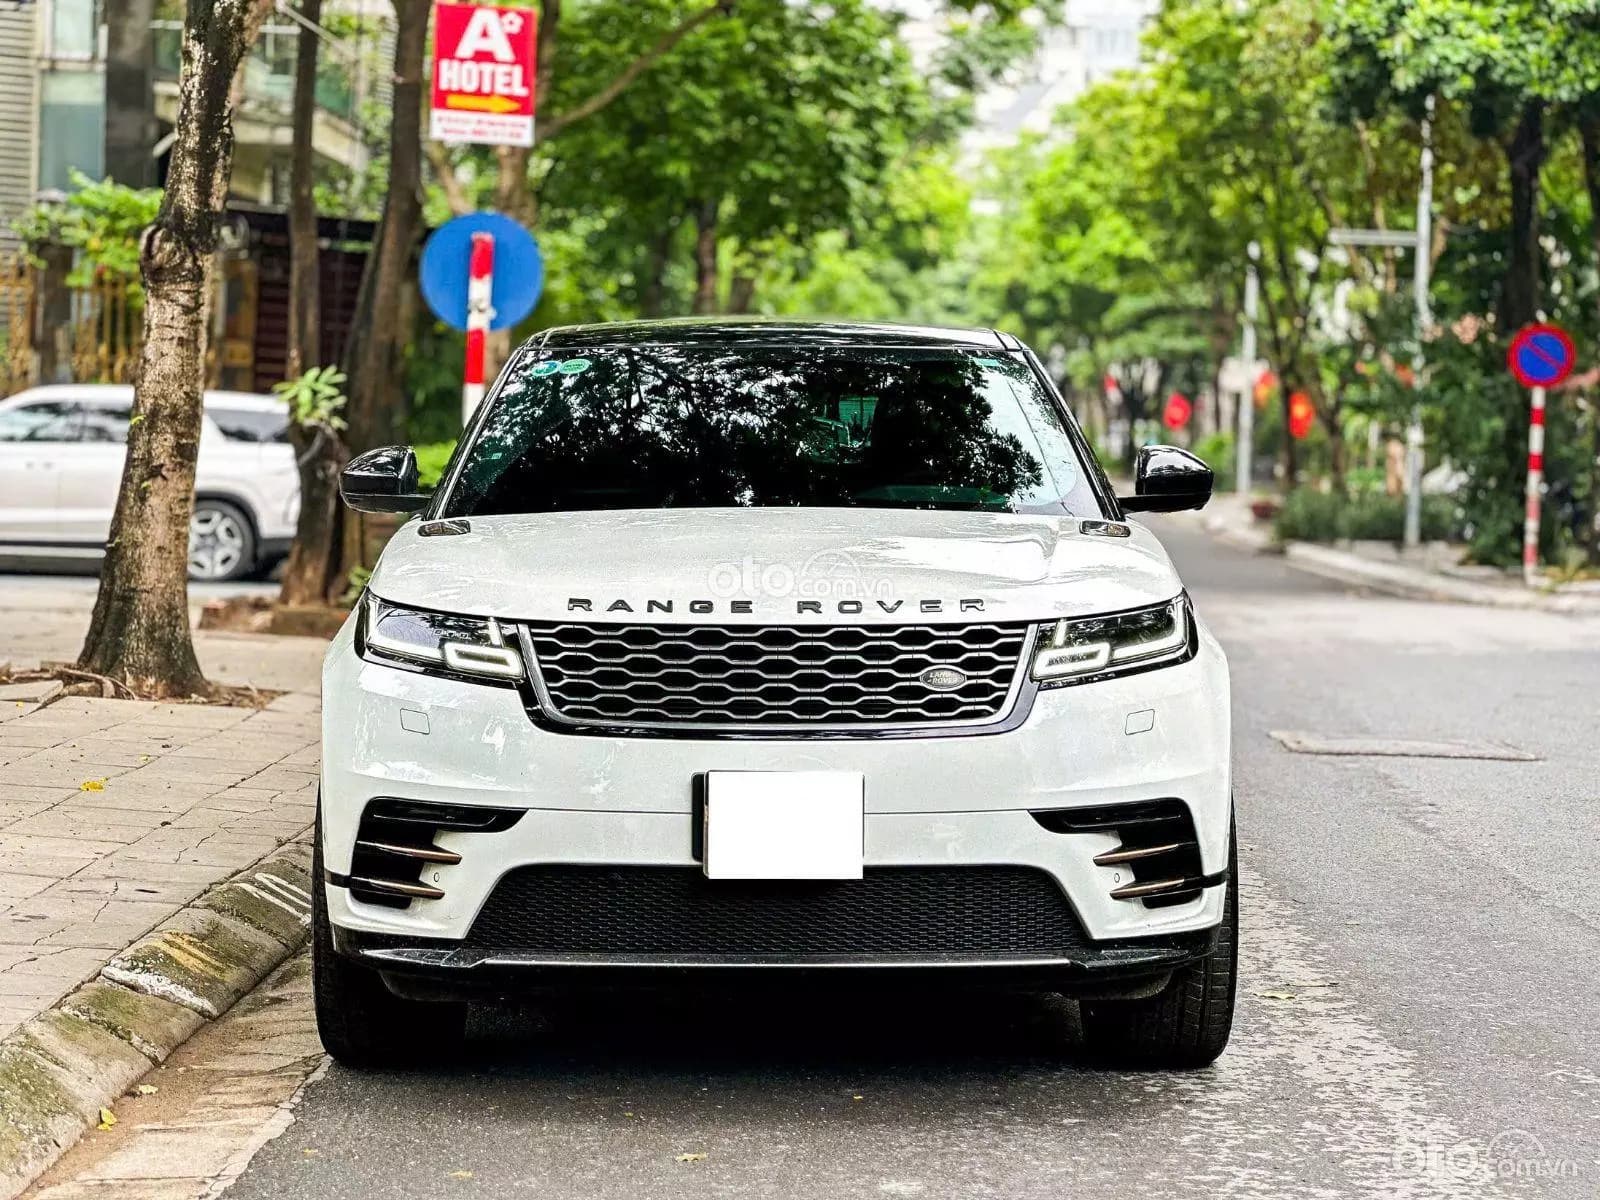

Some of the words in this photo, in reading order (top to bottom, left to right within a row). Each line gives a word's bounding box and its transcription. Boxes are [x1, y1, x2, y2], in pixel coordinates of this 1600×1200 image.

[438, 58, 529, 97] HOTEL
[568, 597, 753, 614] RANGE
[797, 598, 985, 614] ROVER
